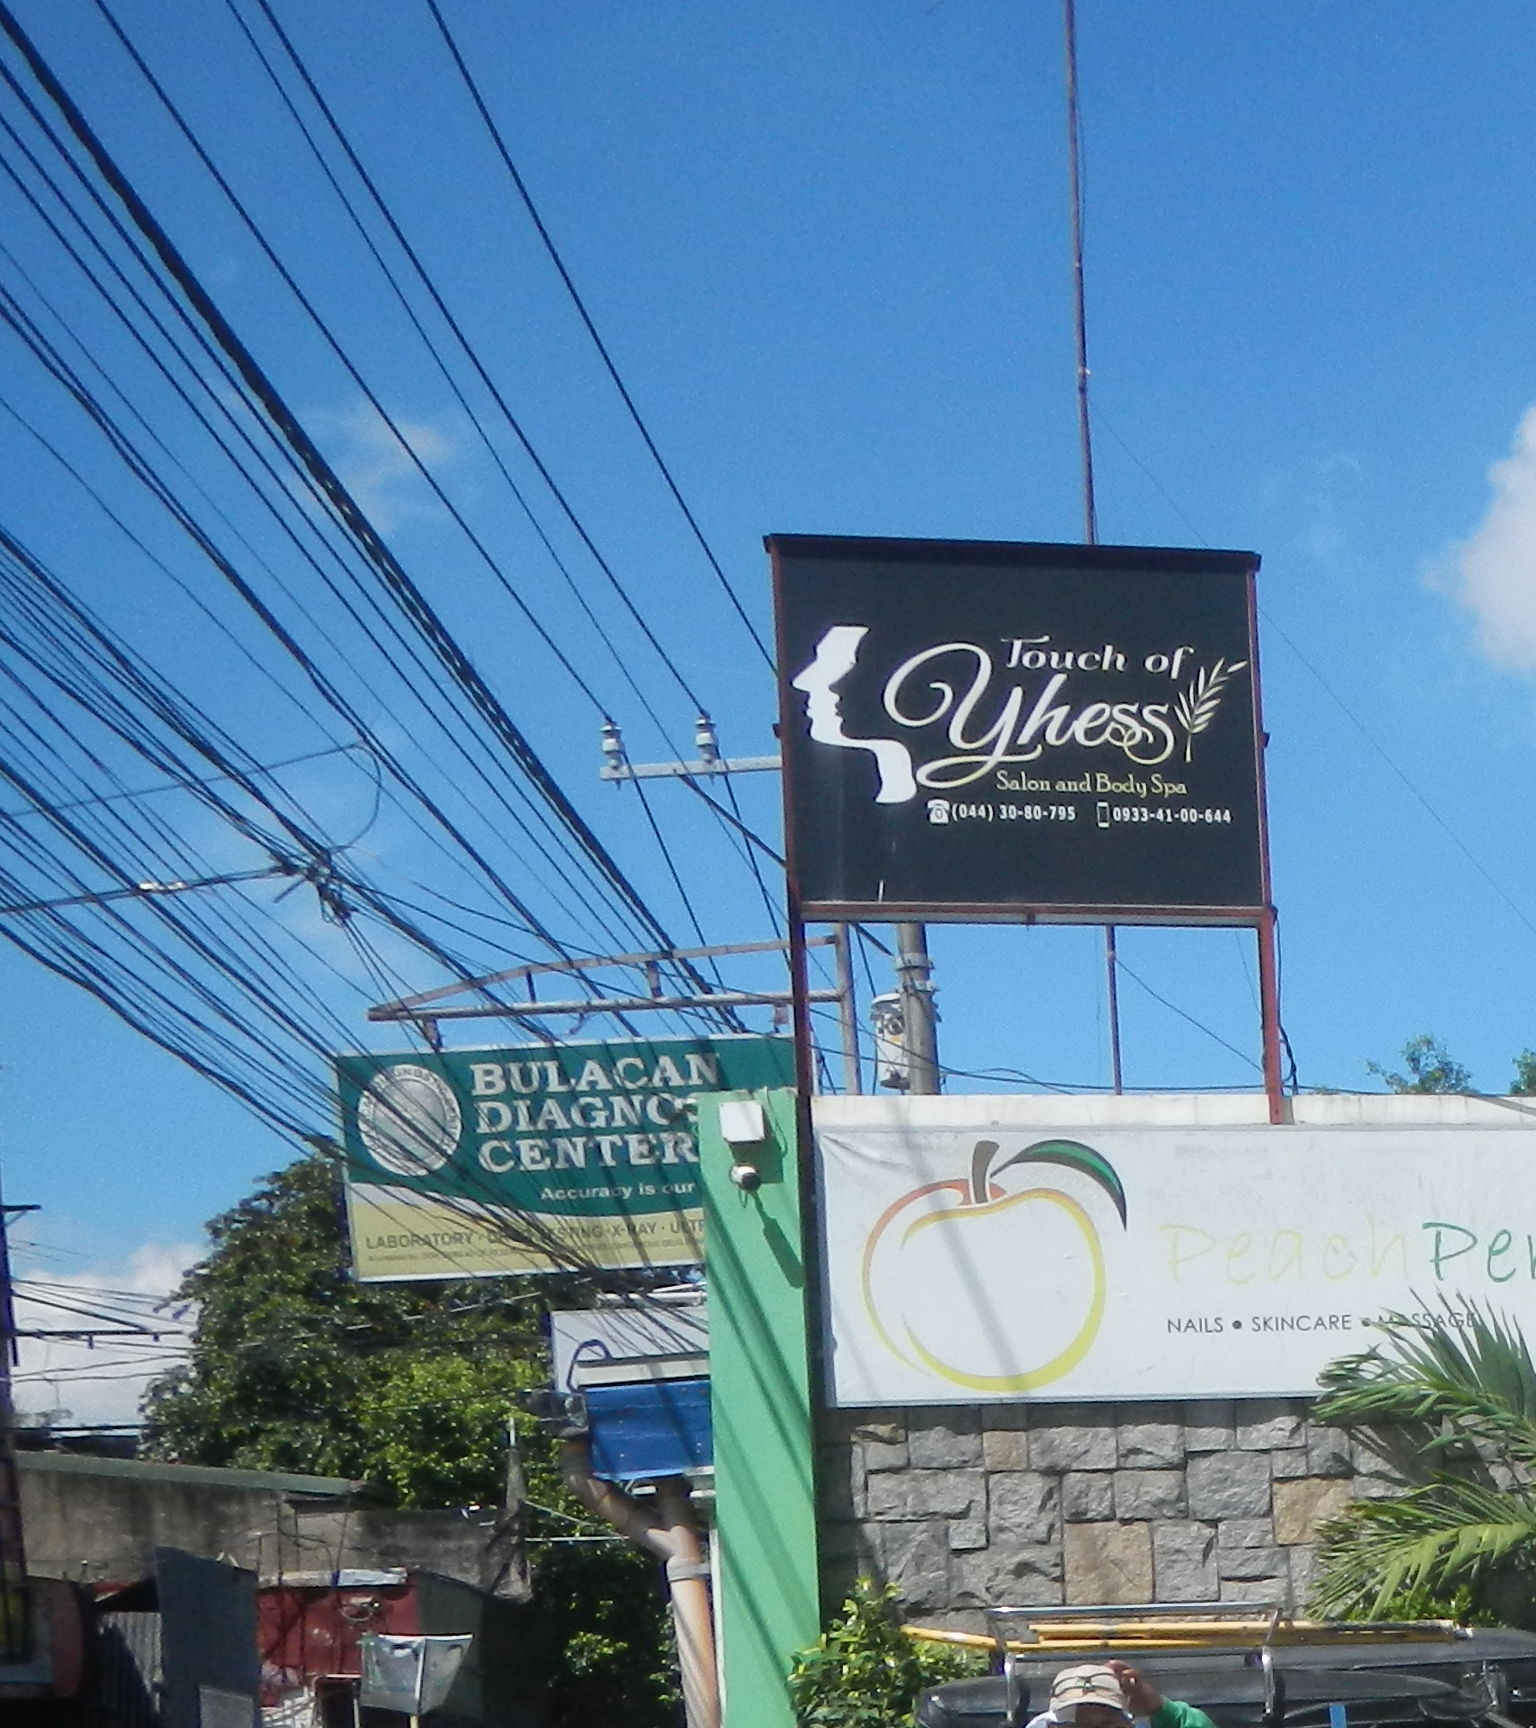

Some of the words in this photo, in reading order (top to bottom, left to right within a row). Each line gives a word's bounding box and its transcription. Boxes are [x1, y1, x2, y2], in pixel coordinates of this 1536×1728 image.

[1001, 635, 1126, 672] Touch
[1145, 645, 1194, 680] of
[883, 642, 1175, 789] Yhess
[996, 770, 1051, 793] Salon
[1055, 773, 1091, 793] and
[1096, 772, 1147, 798] Body
[1150, 774, 1188, 798] Spa
[951, 803, 994, 823] (044)
[999, 805, 1076, 822] 30-80-795
[1112, 806, 1233, 824] 0933-41-00-644
[469, 1053, 720, 1096] BULACAN
[478, 1132, 699, 1174] CENTER
[541, 1184, 633, 1201] Accuracy
[639, 1182, 657, 1197] is
[661, 1182, 696, 1196] our
[366, 1231, 473, 1249] LABORATORY
[1159, 1212, 1410, 1286] Peach
[1168, 1317, 1224, 1333] NAILS
[1251, 1314, 1352, 1332] SKINCARE
